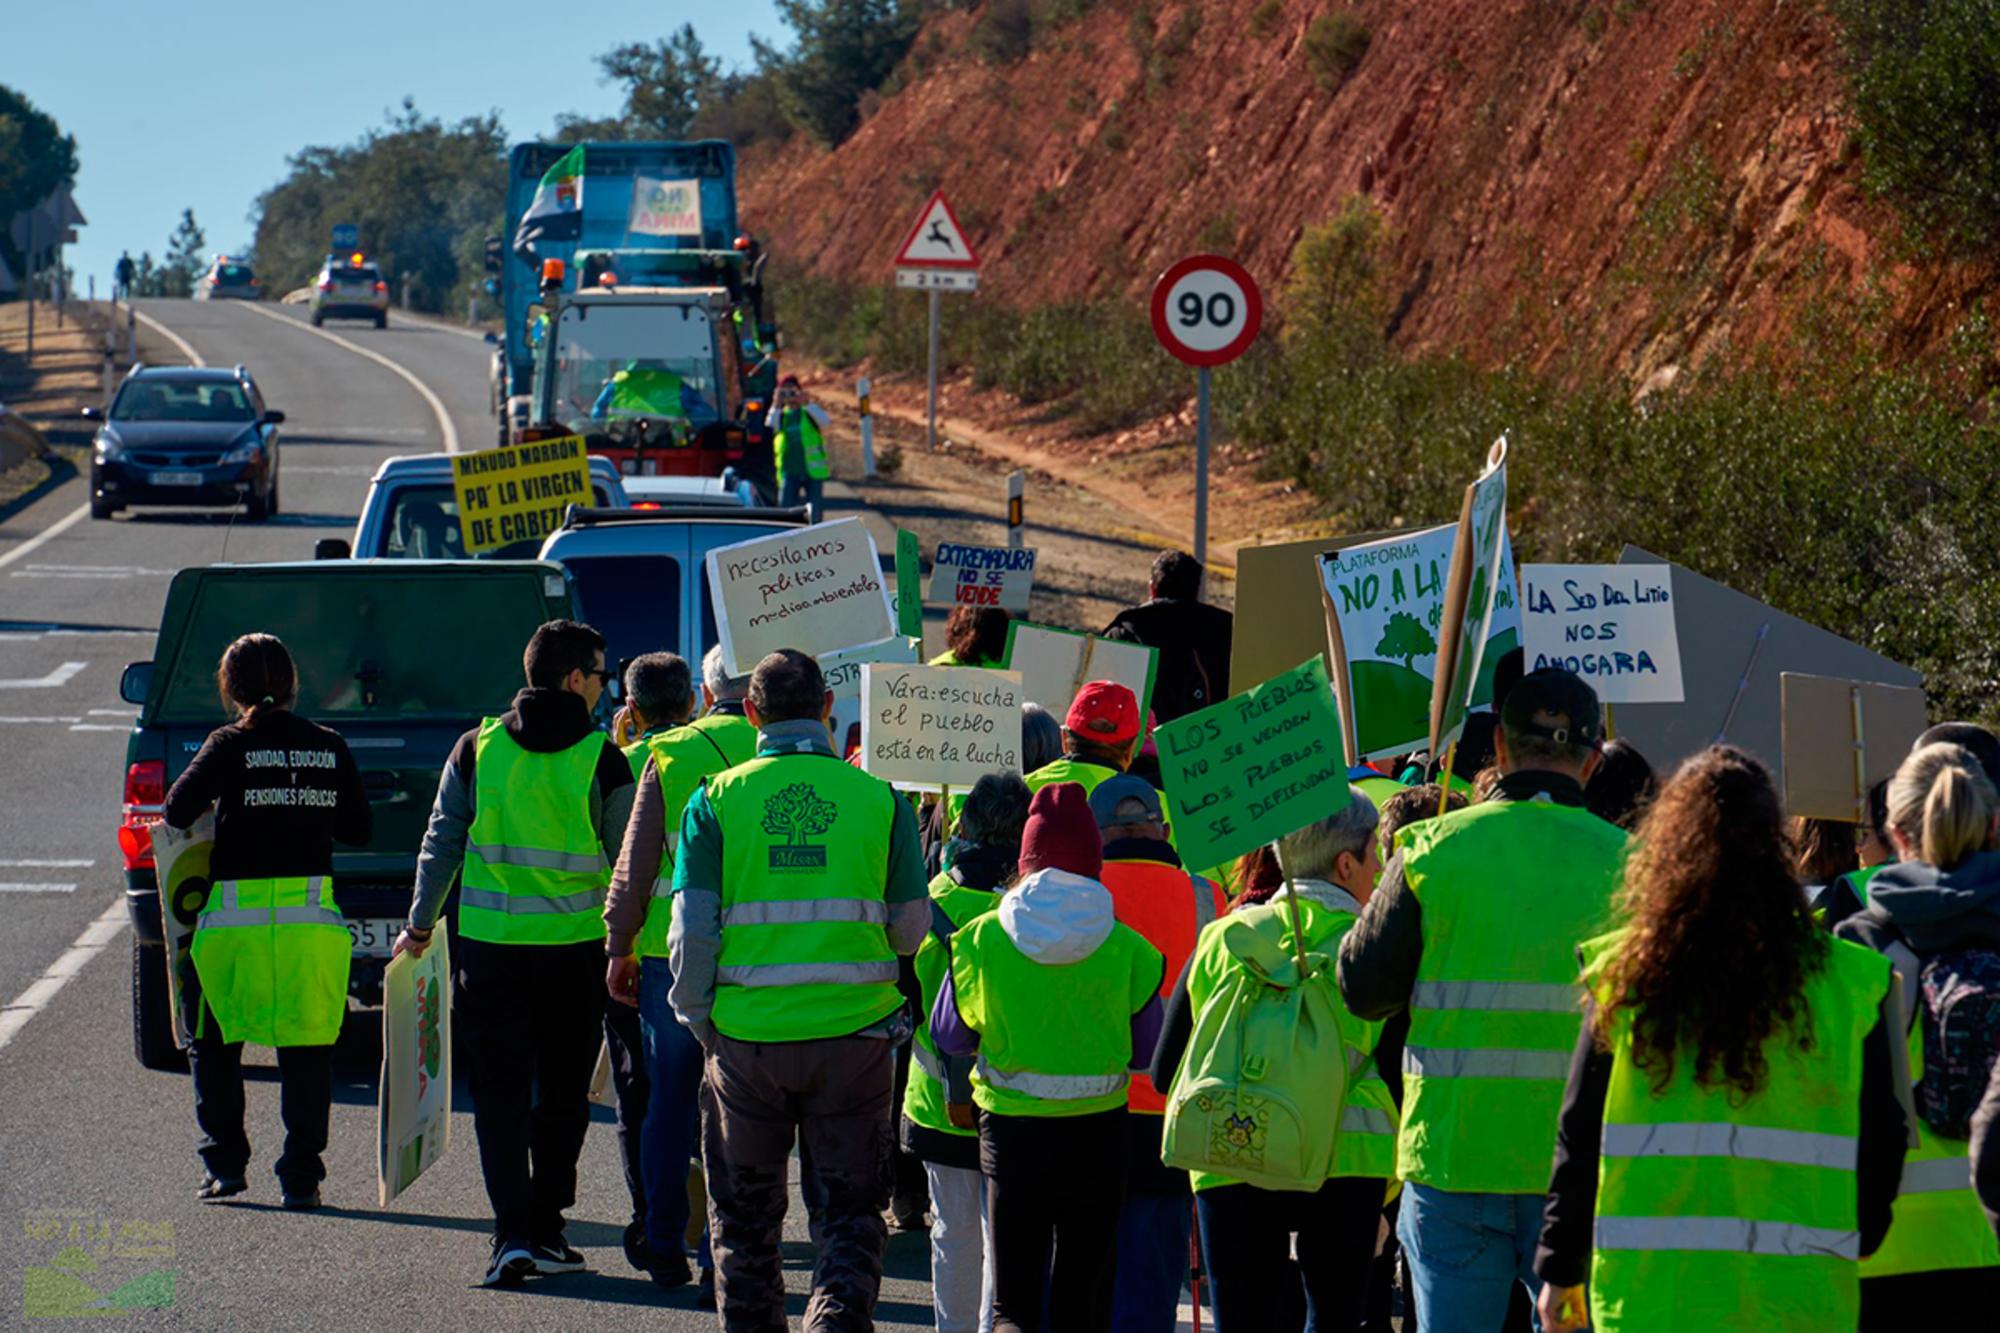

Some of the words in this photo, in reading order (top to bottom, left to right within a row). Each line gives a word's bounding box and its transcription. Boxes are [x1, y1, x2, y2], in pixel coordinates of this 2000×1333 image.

[1178, 291, 1235, 328] 90
[460, 451, 517, 475] MENUDO
[497, 481, 519, 505] LA
[522, 470, 584, 501] VIRGEN
[471, 518, 497, 546] DE
[500, 498, 569, 541] CABEZ
[936, 543, 1035, 571] EXTREMADURA
[1330, 542, 1420, 577] PLATAFORMA
[958, 568, 979, 583] NO
[985, 570, 1005, 586] SE
[1337, 573, 1380, 615] NO
[1391, 568, 1406, 605] A
[1414, 560, 1442, 599] LA
[748, 573, 880, 628] medioambientales
[956, 583, 1002, 606] VENDE
[1528, 582, 1556, 614] LA
[1565, 622, 1618, 643] NOS
[1532, 650, 1657, 676] AHOGARA
[881, 703, 907, 726] el
[919, 712, 995, 734] pueblo
[1168, 717, 1222, 756] LOS
[1235, 672, 1317, 725] PUEBLOS
[244, 749, 289, 769] SANIDAD,
[289, 748, 337, 769] EDUCACIÓN
[876, 738, 913, 761] está
[916, 744, 936, 762] en
[939, 742, 961, 763] la
[964, 742, 1017, 767] lucha
[1182, 758, 1209, 784] NO
[1220, 743, 1244, 764] SE
[1252, 709, 1312, 746] VENDEN
[290, 771, 298, 785] Y
[1180, 785, 1235, 816] LOS
[1242, 738, 1325, 789] PUEBLOS
[243, 788, 297, 807] PENSIONES
[297, 785, 338, 807] PÚBLICAS
[1208, 815, 1237, 843] SE
